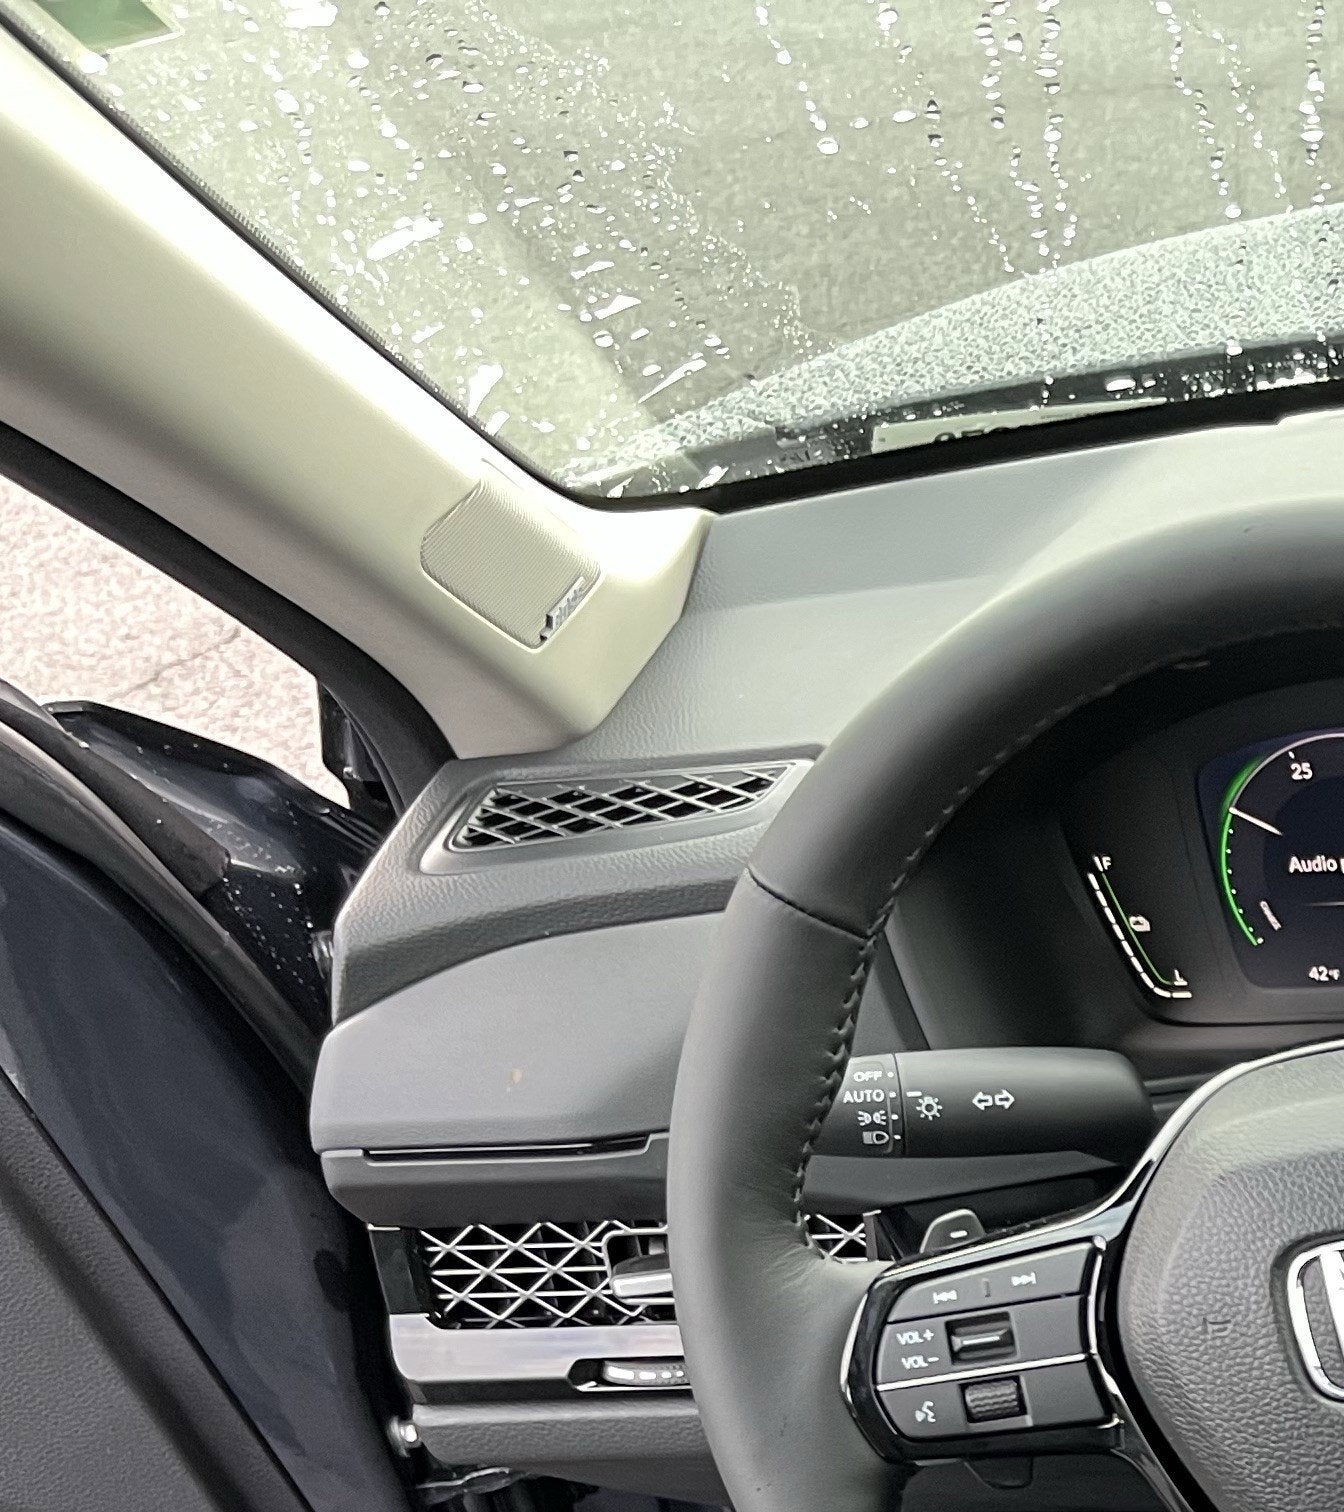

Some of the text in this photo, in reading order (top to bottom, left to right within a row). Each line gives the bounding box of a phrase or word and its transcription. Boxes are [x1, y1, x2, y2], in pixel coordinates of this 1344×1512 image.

[1291, 761, 1313, 781] 25
[1289, 855, 1338, 874] Audio
[853, 1071, 883, 1082] OFF
[843, 1089, 886, 1104] AUTO
